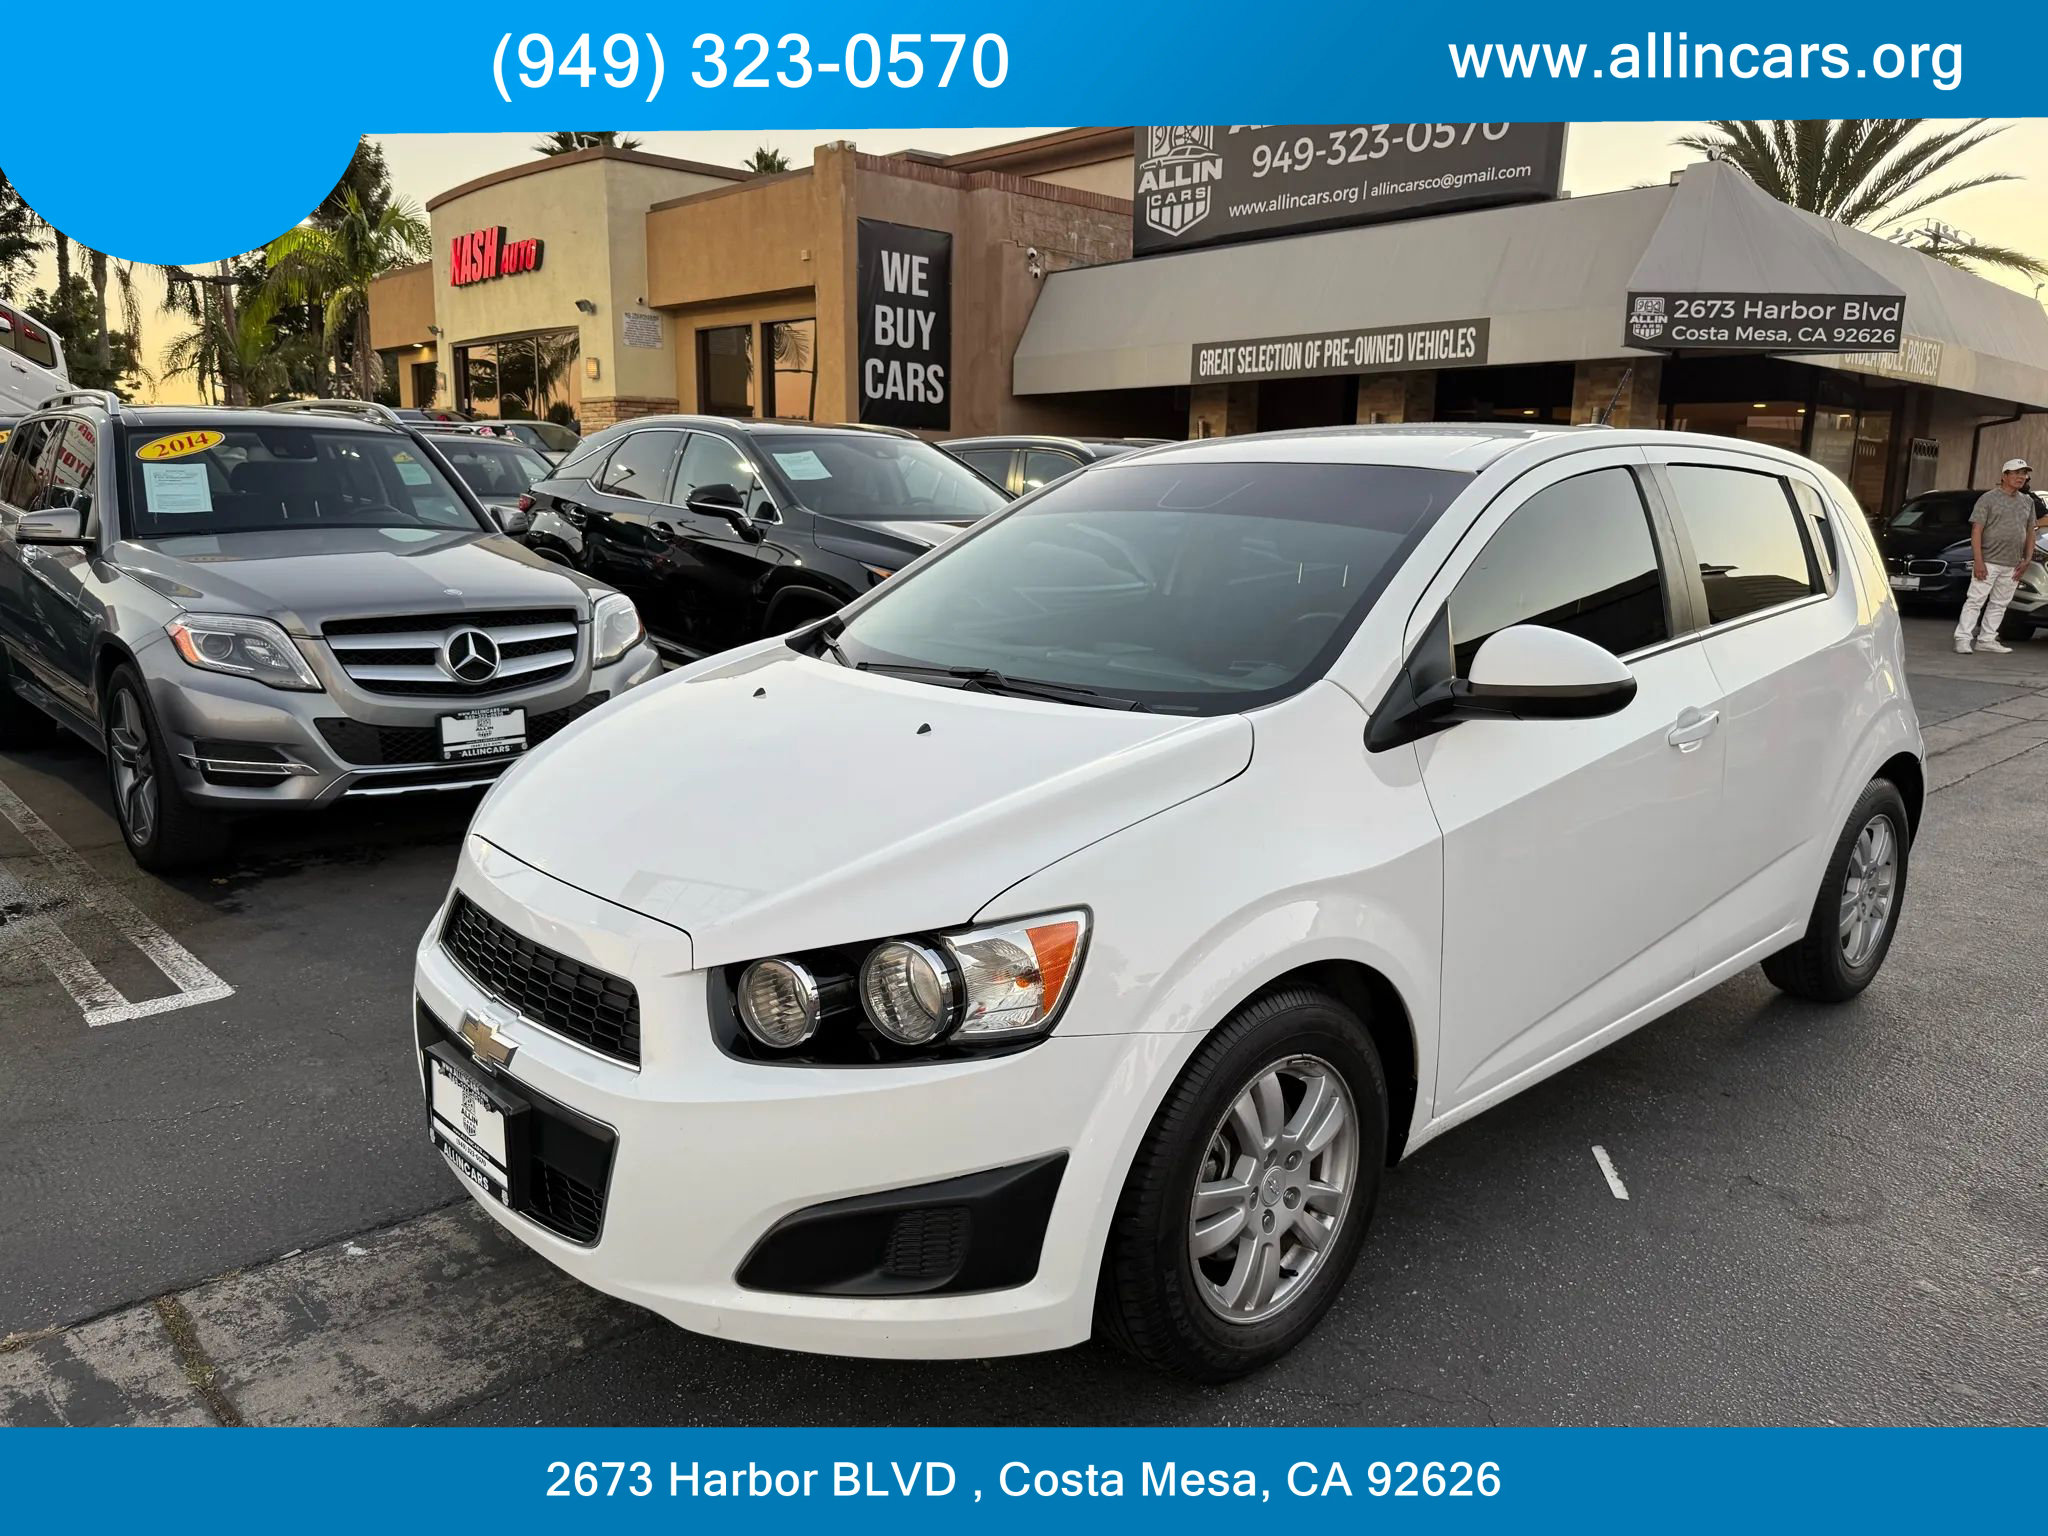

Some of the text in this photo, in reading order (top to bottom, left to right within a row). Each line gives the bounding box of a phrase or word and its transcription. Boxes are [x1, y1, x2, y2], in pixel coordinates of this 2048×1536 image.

[1138, 158, 1223, 193] ALLIN
[1228, 165, 1532, 218] www.allincars.org allincarsco@gmail.com
[1151, 187, 1206, 207] CARS
[450, 226, 540, 287] NASH AUTO
[881, 250, 929, 297] WE
[875, 304, 936, 350] BUY
[1630, 315, 1668, 324] ALLIN
[1674, 300, 1900, 322] 2673 Harbor Blvd
[1199, 327, 1476, 376] GREAT SELECTION OF PRE-OWNED VEHICLES
[1671, 326, 1895, 343] Costa Mesa, CA 92626
[1905, 339, 1940, 377] PRICES!
[865, 358, 944, 404] CARS
[153, 432, 209, 457] 2014
[461, 745, 510, 757] ALLINCARS
[443, 1142, 489, 1191] ALLINCARS
